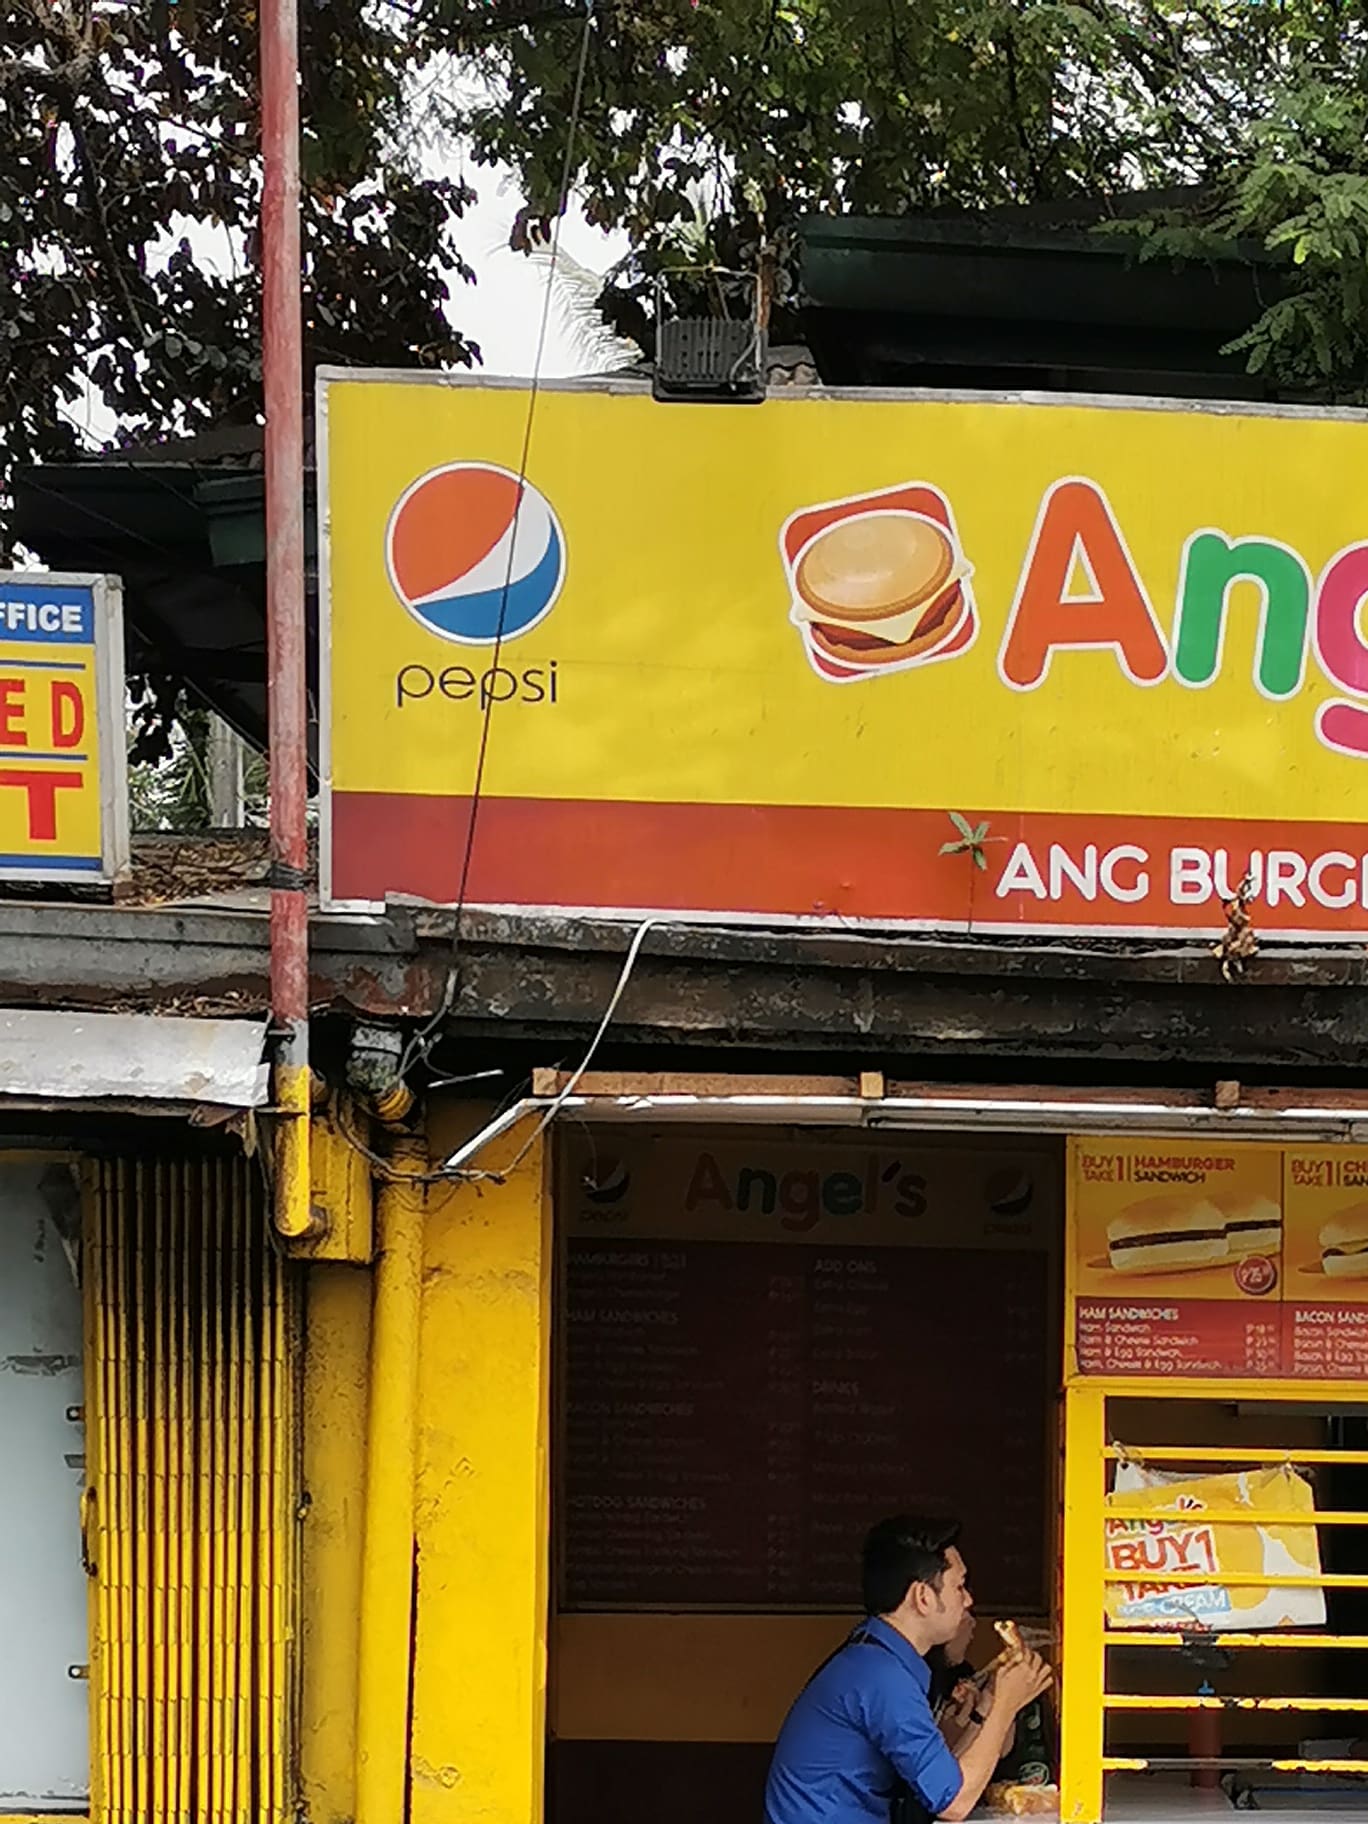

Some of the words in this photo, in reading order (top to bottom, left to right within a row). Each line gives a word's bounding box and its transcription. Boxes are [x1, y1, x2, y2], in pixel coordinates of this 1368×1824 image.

[396, 660, 559, 711] pepsi
[996, 843, 1149, 904] ANG
[1081, 1155, 1113, 1169] BUY
[1134, 1155, 1236, 1171] HAMBURGER
[1291, 1159, 1323, 1173] BUY
[1134, 1170, 1206, 1184] SANDWICH
[684, 1152, 929, 1233] Angel's
[1295, 1311, 1334, 1324] BACON
[1111, 1532, 1195, 1571] BUY
